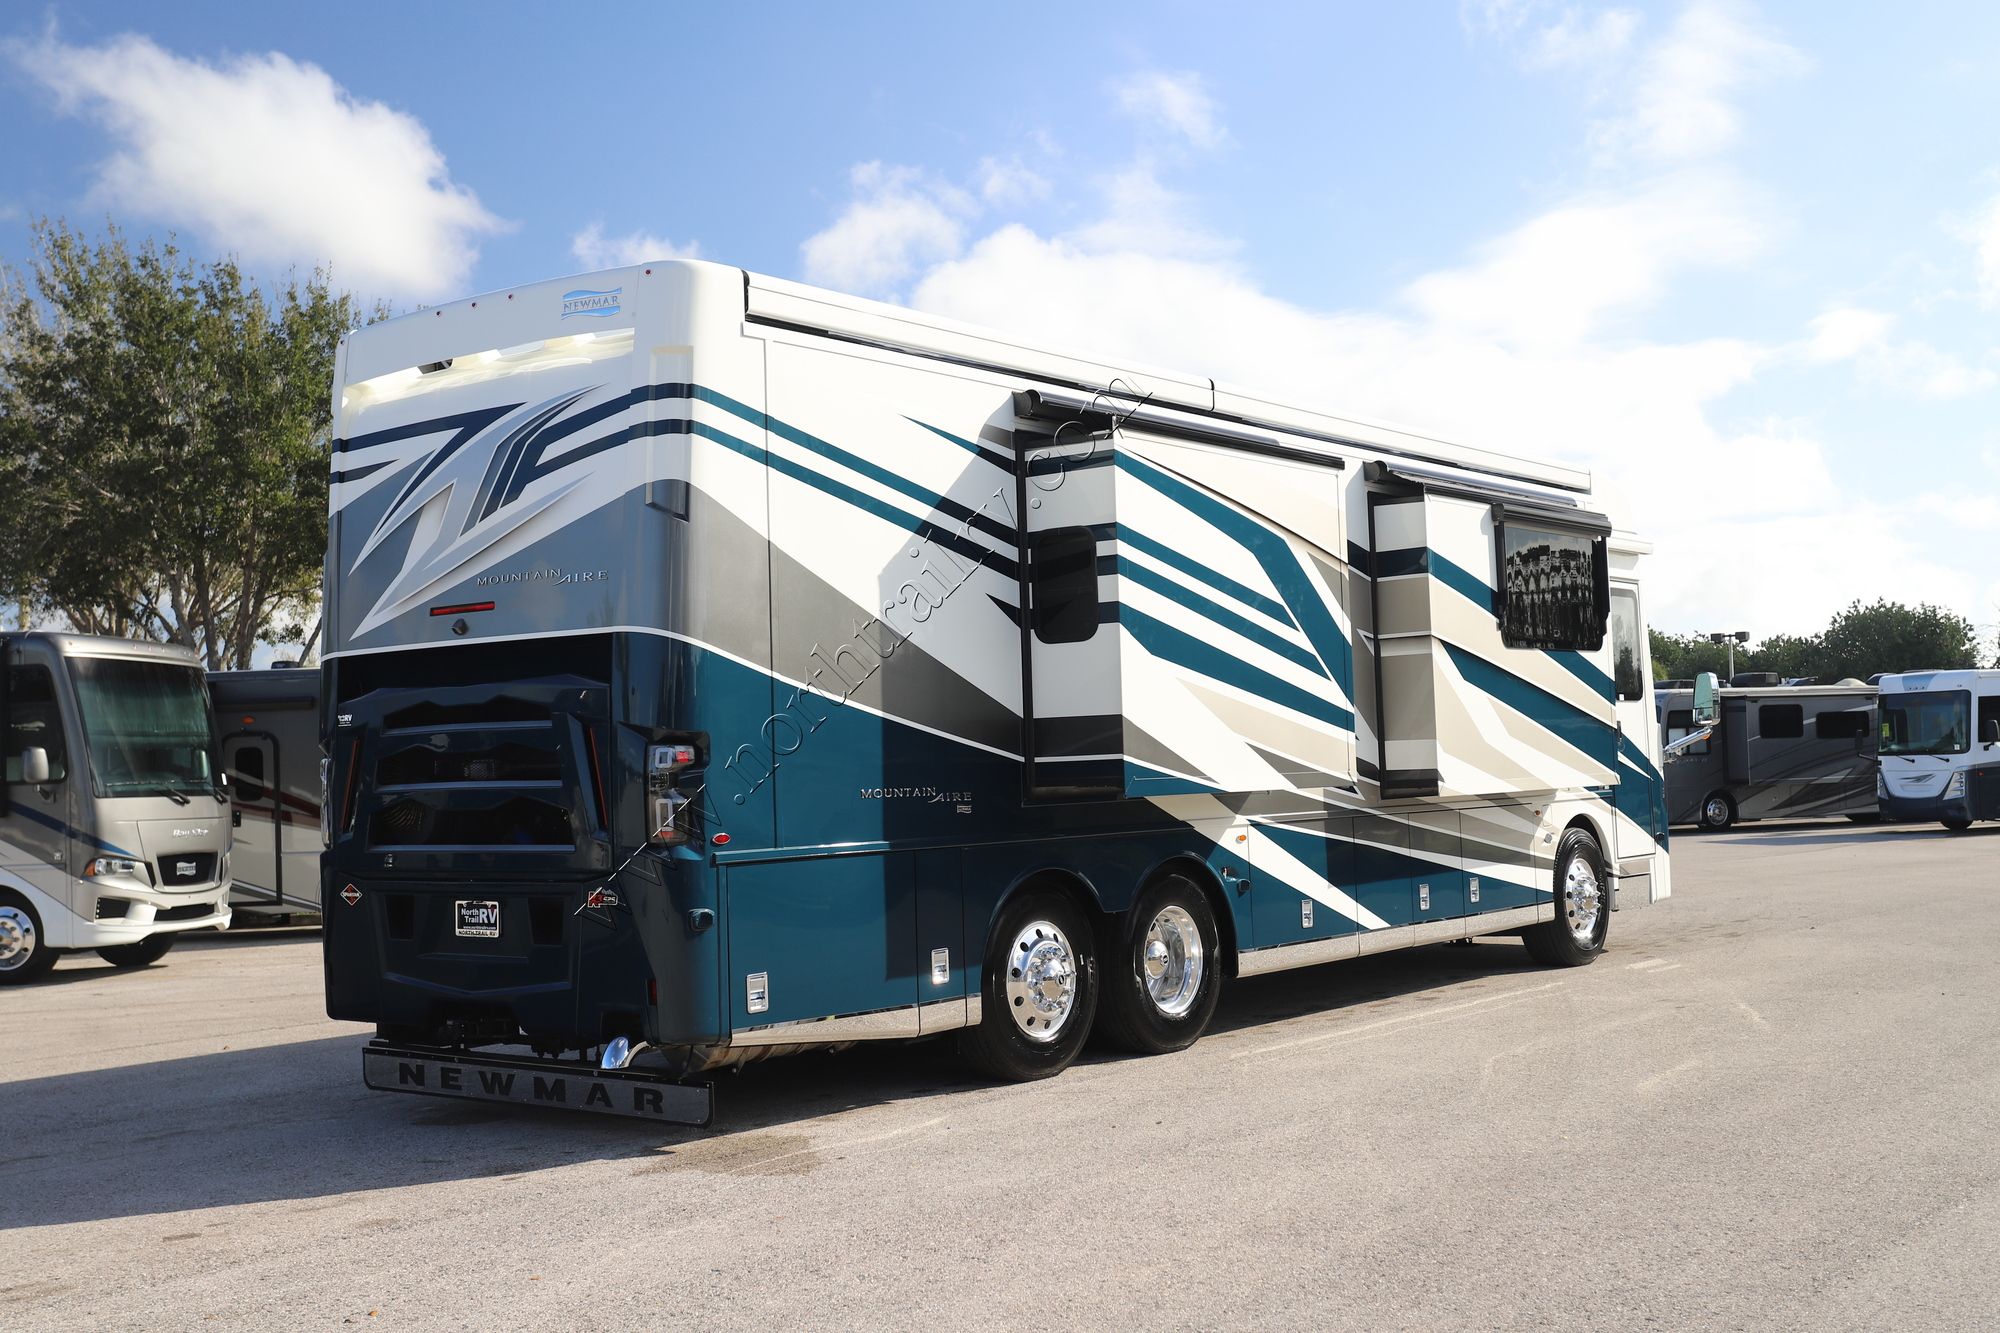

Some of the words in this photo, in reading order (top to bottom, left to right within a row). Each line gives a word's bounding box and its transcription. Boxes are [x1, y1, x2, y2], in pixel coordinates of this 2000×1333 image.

[563, 295, 620, 313] NEWMAR
[477, 568, 561, 586] MOUNTAIN
[552, 570, 608, 587] AIRE
[860, 787, 936, 799] MOUNTAIN
[927, 791, 972, 803] AIRE
[480, 909, 497, 924] RV
[398, 1062, 664, 1114] NEWMAR
